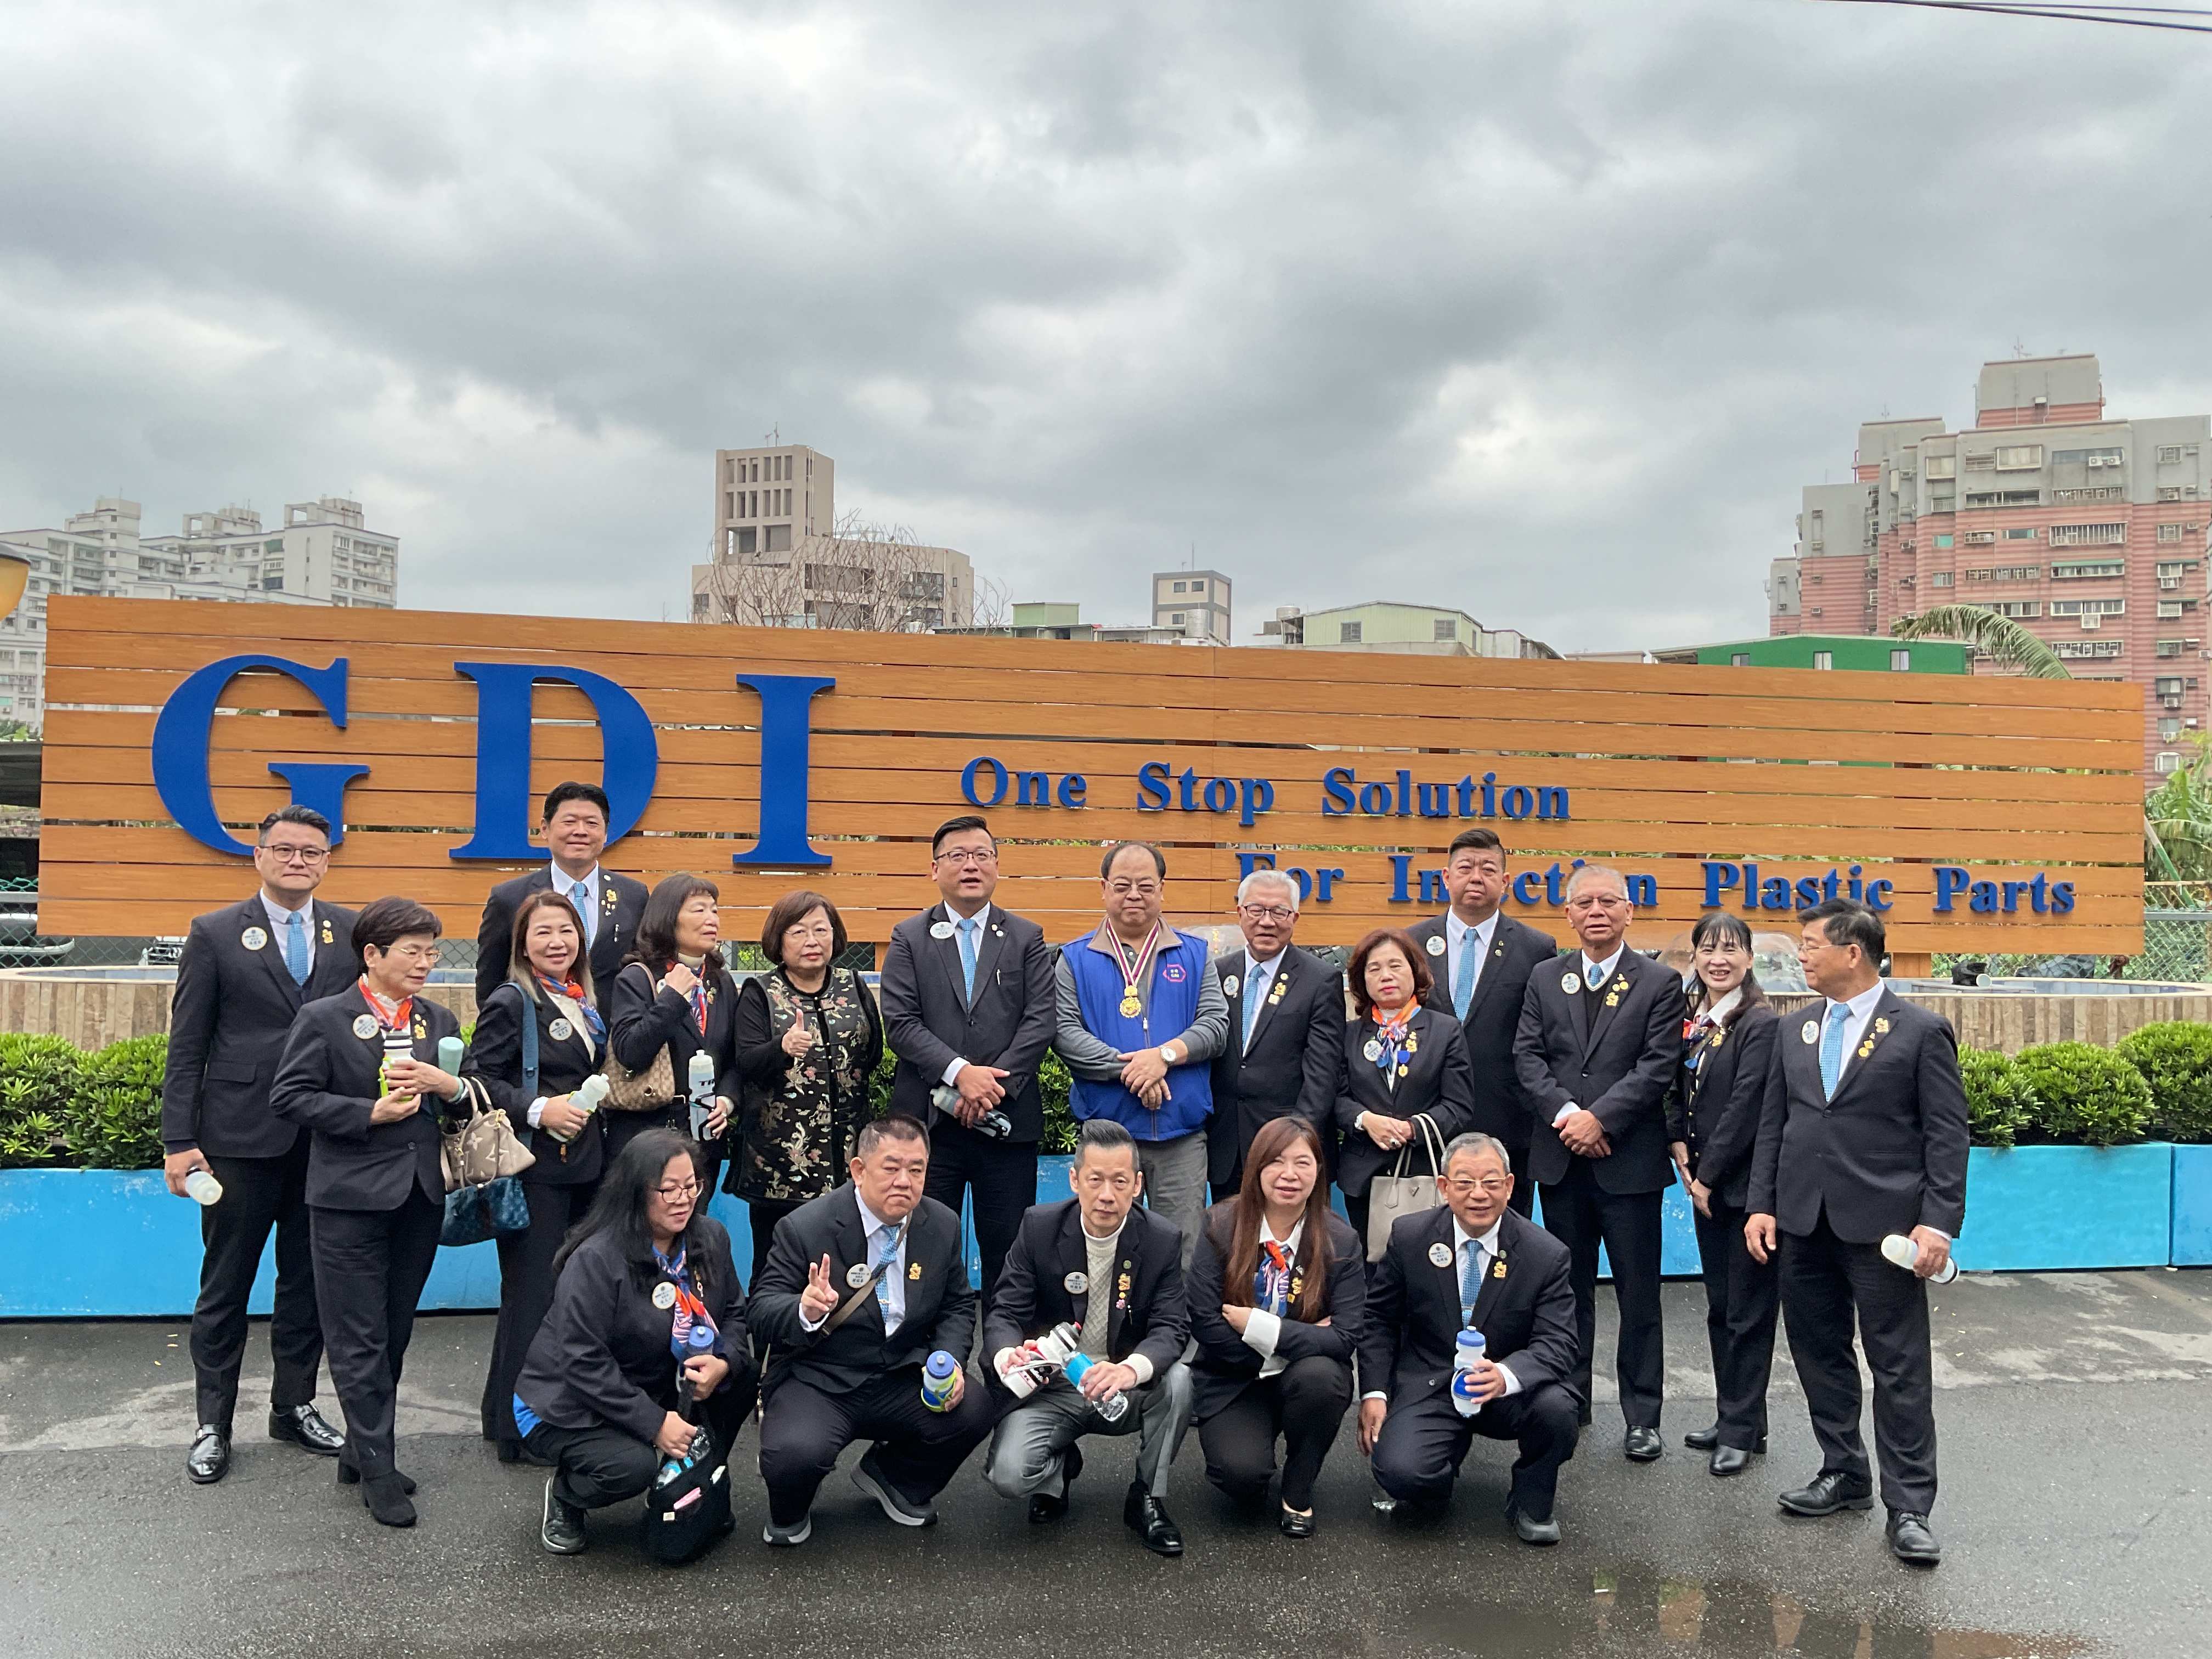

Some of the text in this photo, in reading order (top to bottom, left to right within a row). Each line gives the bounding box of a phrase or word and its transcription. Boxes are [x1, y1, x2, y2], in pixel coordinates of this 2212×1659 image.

[152, 654, 837, 866] GDI
[961, 756, 1571, 827] One Stop Solution
[1387, 855, 1658, 906] Inctn
[1700, 862, 1894, 911] Plastic
[1933, 867, 2075, 914] Parts
